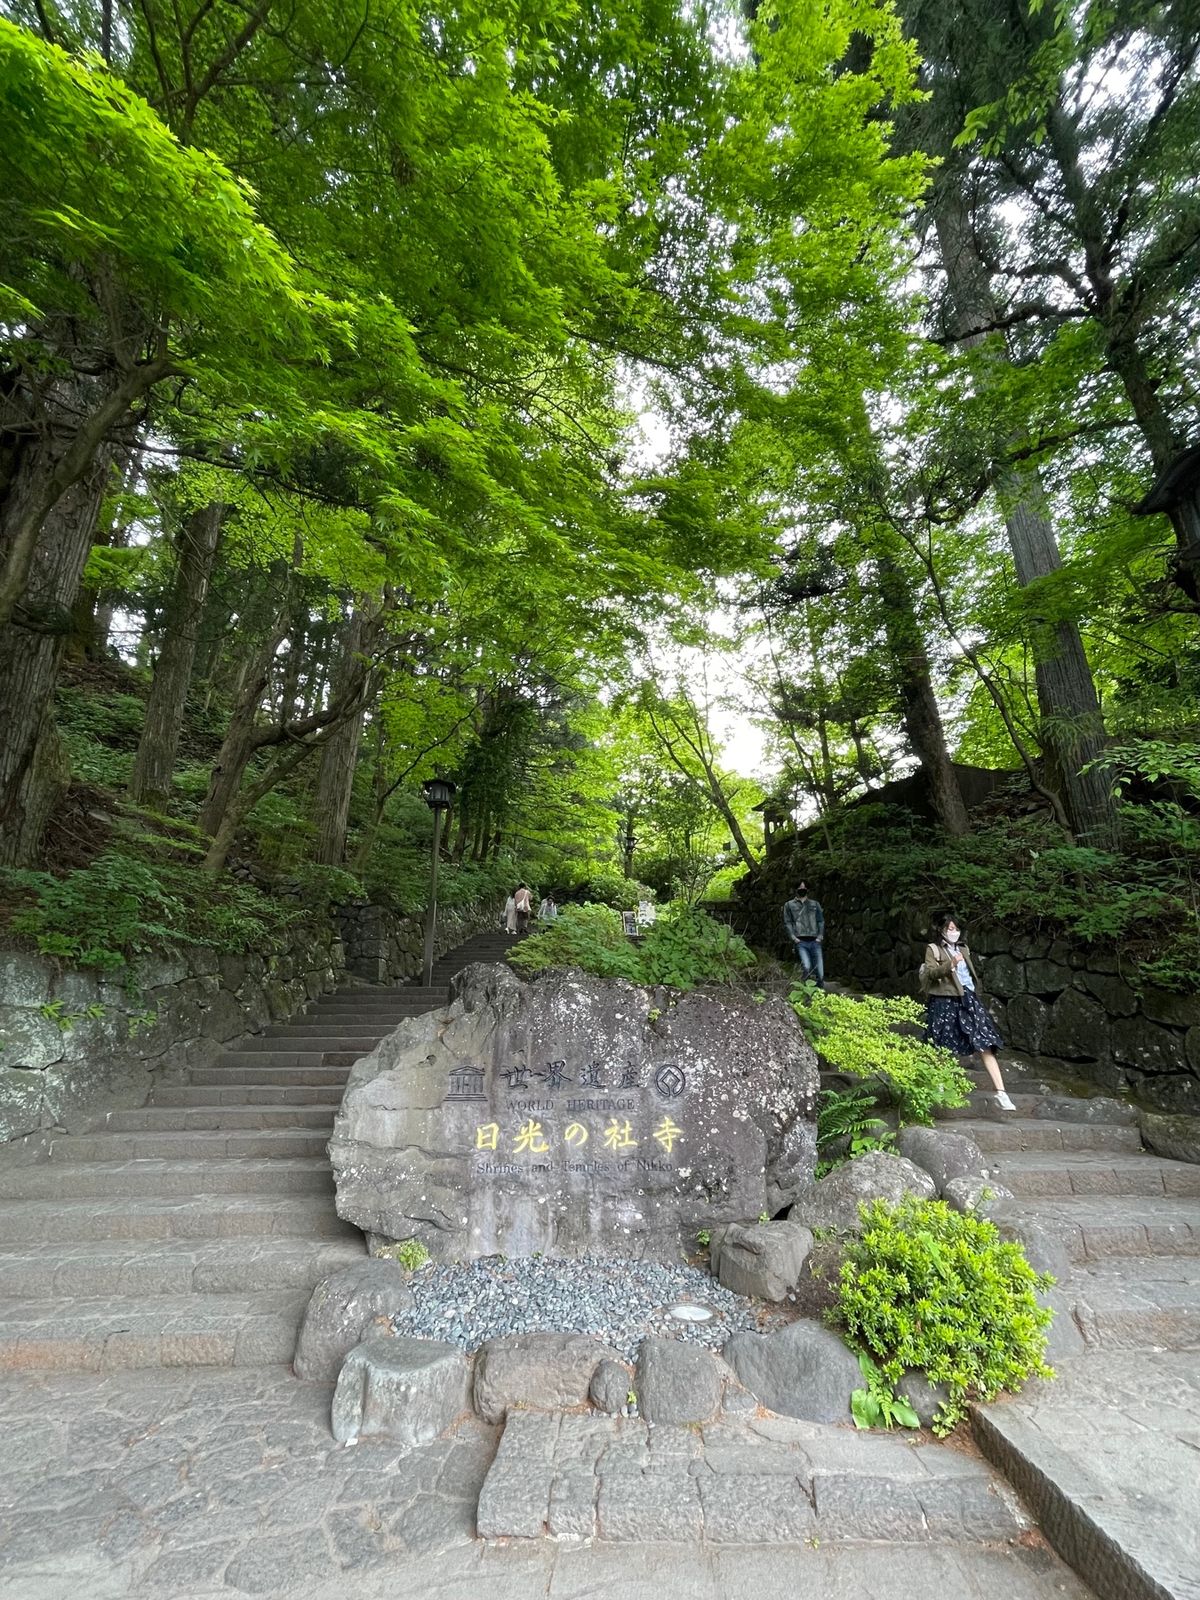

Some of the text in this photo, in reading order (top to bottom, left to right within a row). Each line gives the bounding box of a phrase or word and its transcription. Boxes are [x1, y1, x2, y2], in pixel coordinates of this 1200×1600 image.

[500, 1059, 640, 1090] 世界遺産
[506, 1098, 635, 1112] WORLD HERITAGE
[476, 1115, 683, 1154] 日光の社寺
[476, 1163, 524, 1175] Shrines
[531, 1161, 553, 1173] and
[617, 1160, 632, 1172] of
[637, 1159, 673, 1172] Nikko
